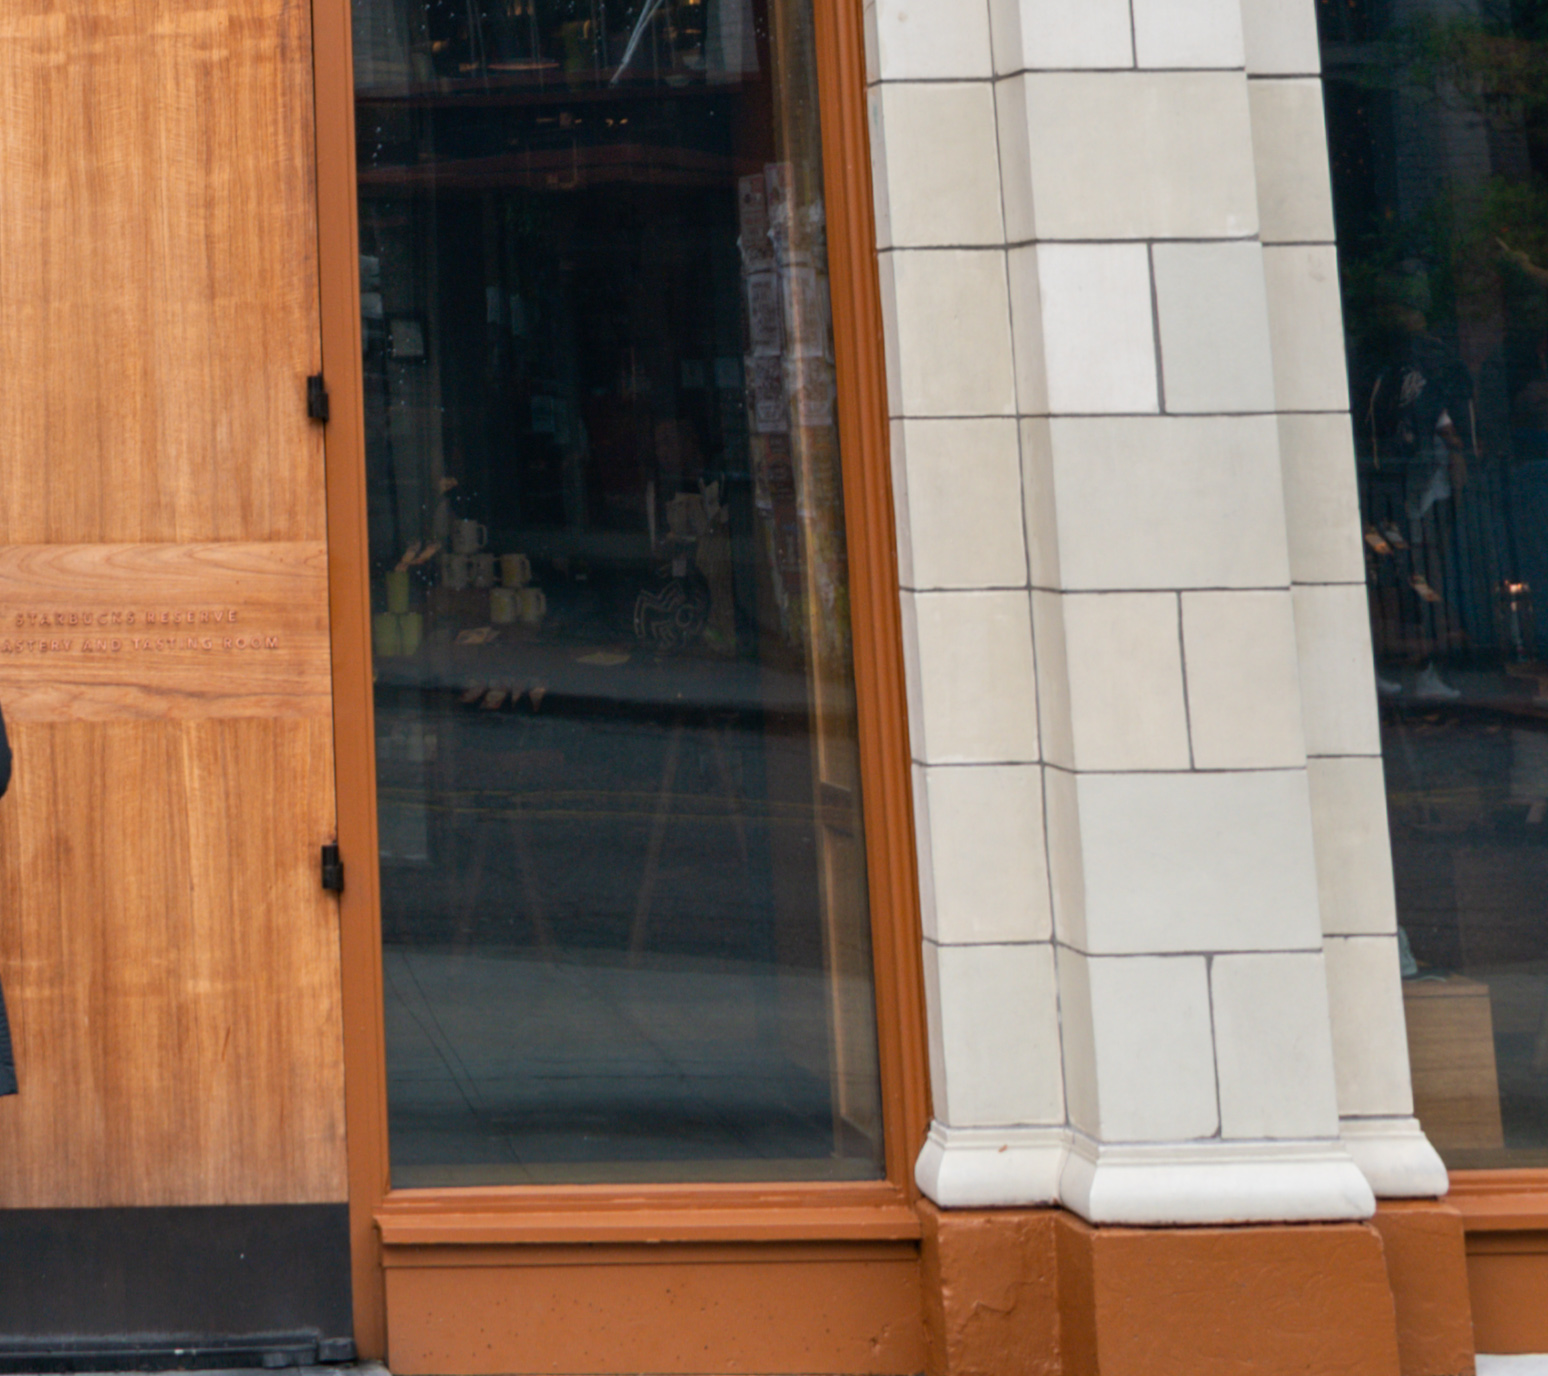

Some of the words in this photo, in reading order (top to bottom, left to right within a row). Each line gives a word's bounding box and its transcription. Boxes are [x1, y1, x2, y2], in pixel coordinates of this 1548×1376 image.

[15, 611, 136, 627] STARBUCKS
[146, 609, 238, 624] RESERVE
[81, 638, 122, 653] AND
[132, 637, 213, 652] TASTING
[223, 635, 279, 649] ROOM
